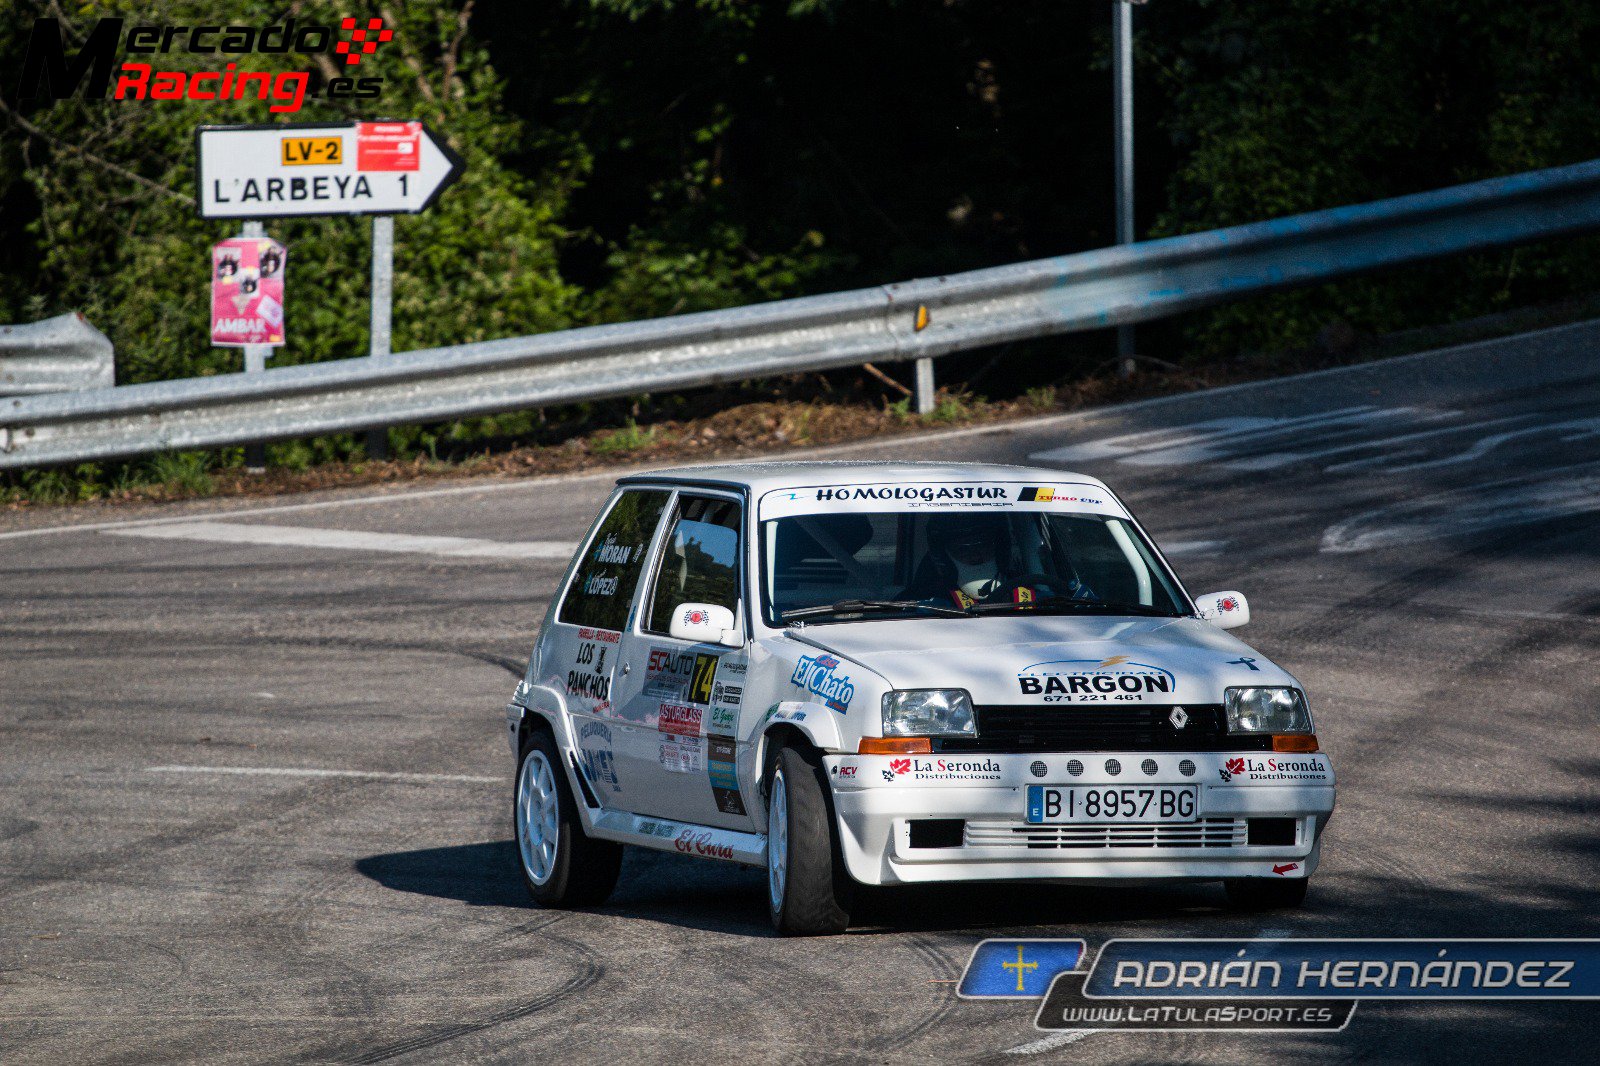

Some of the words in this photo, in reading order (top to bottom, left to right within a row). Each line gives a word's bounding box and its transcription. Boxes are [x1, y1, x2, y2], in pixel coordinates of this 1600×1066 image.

[285, 142, 339, 161] LV-2
[215, 175, 372, 202] L'ARBEYA
[399, 174, 408, 197] 1
[816, 487, 1007, 501] HOMOLOGASTUR
[576, 642, 595, 664] LOS
[566, 670, 610, 700] PANCHOS
[691, 656, 717, 702] 74
[809, 665, 854, 704] Chato
[1018, 675, 1169, 695] BARGON
[660, 704, 702, 724] ASTURGLASS
[914, 759, 932, 772] La
[937, 758, 1001, 772] Seronda
[1247, 759, 1265, 772] La
[1268, 758, 1326, 772] Seronda
[1032, 808, 1039, 816] E
[1045, 790, 1074, 817] BI
[1085, 790, 1155, 817] 8957
[1160, 790, 1194, 817] BG
[675, 829, 696, 852] El
